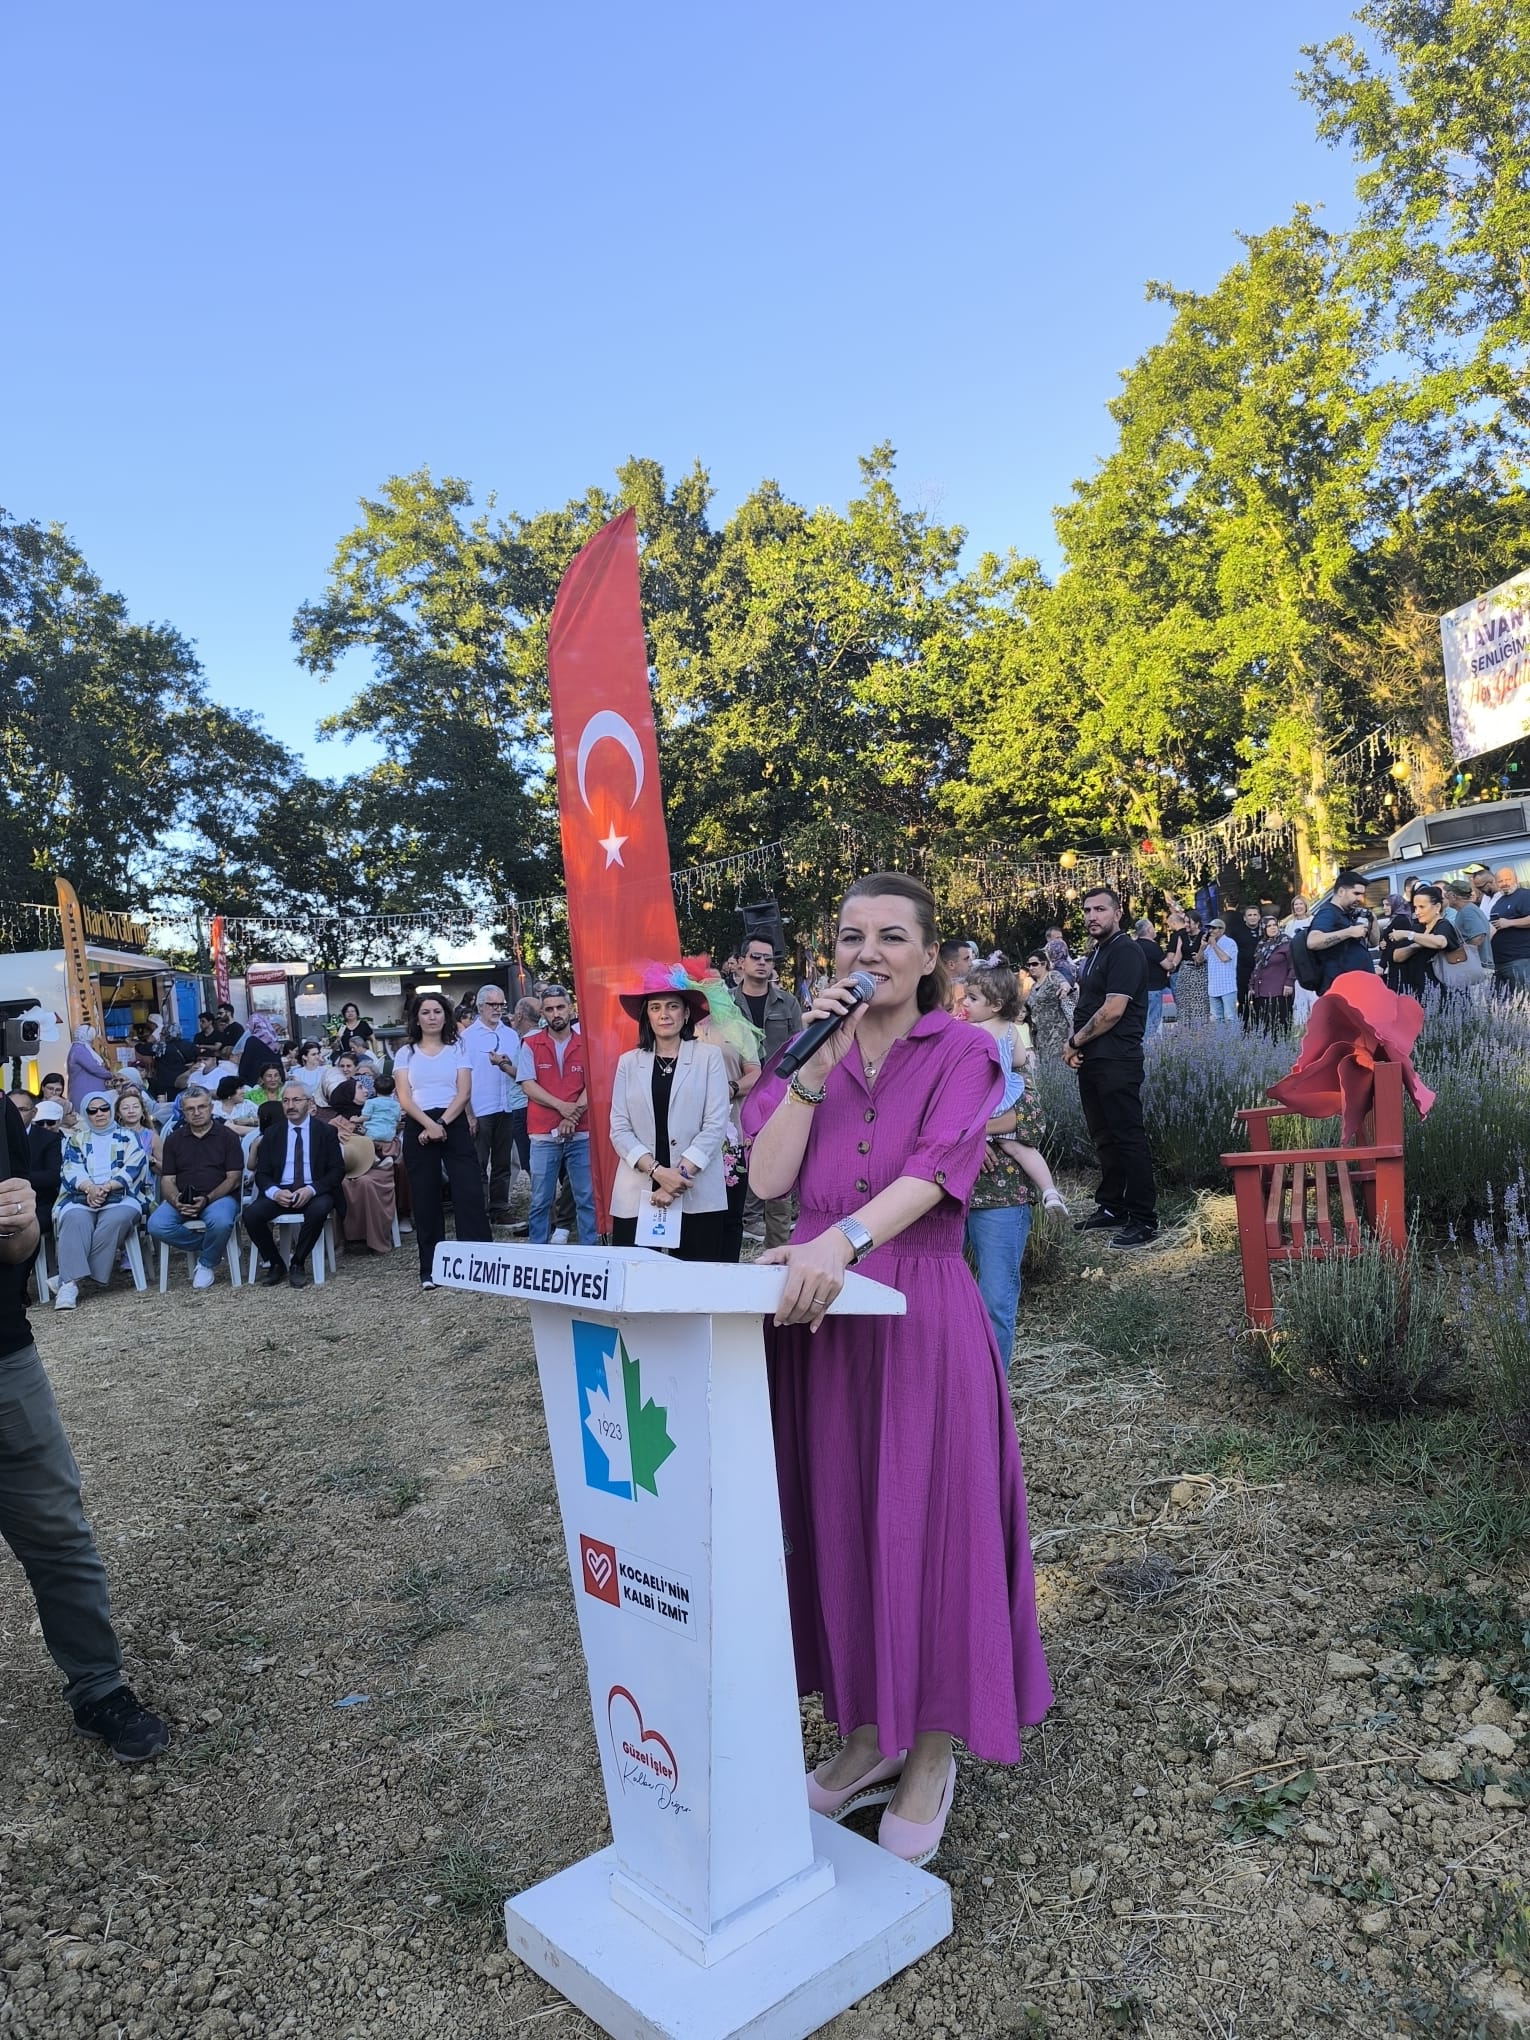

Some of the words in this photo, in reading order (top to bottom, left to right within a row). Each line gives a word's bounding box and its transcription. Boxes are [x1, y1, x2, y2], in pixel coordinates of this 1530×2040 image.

[1464, 604, 1530, 653] LAVAN
[83, 904, 118, 939] Harika
[442, 1256, 465, 1280] T.C.
[468, 1253, 511, 1286] İZMİT
[512, 1263, 609, 1301] BELEDİYESİ
[597, 1418, 623, 1441] 1923
[619, 1563, 689, 1603] KOCAELİ'NİN
[624, 1585, 654, 1610] KALBİ
[657, 1595, 688, 1624] İZMİT
[622, 1741, 649, 1766] Güzel
